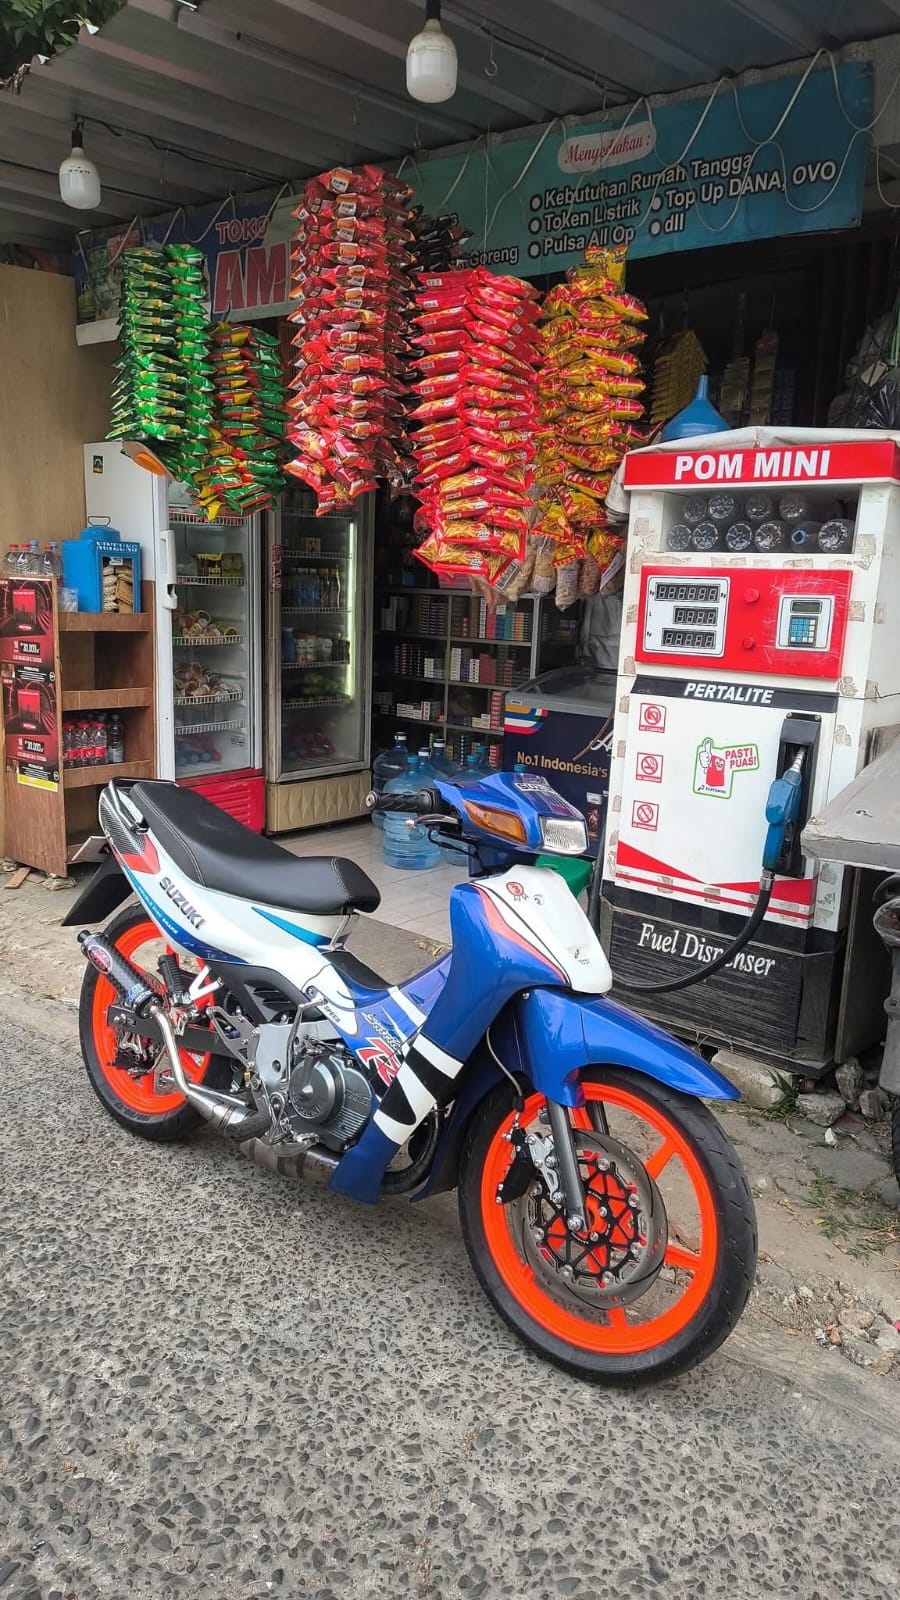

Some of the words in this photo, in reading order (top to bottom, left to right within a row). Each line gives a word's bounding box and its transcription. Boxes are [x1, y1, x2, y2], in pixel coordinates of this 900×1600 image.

[545, 180, 627, 209] Kebutuhan
[631, 166, 686, 191] Rumah
[691, 152, 753, 180] Tangga
[666, 190, 696, 211] Top
[700, 185, 724, 206] Up
[792, 161, 836, 186] OVO
[215, 216, 269, 245] TOKO
[545, 214, 589, 234] Token
[594, 200, 640, 222] Listrik
[664, 213, 685, 234] dll
[543, 235, 586, 256] Pulsa
[588, 226, 608, 249] All
[612, 224, 635, 248] Op
[469, 246, 519, 267] Goreng
[674, 453, 743, 481] POM
[753, 449, 831, 478] MINI
[684, 682, 774, 704] PERTALITE
[517, 752, 539, 766] No.1
[541, 755, 608, 778] Indonesia's
[725, 747, 753, 760] PASTI
[730, 756, 757, 769] PUAS!
[159, 876, 206, 930] SUZUKI
[637, 923, 678, 955] Fuel
